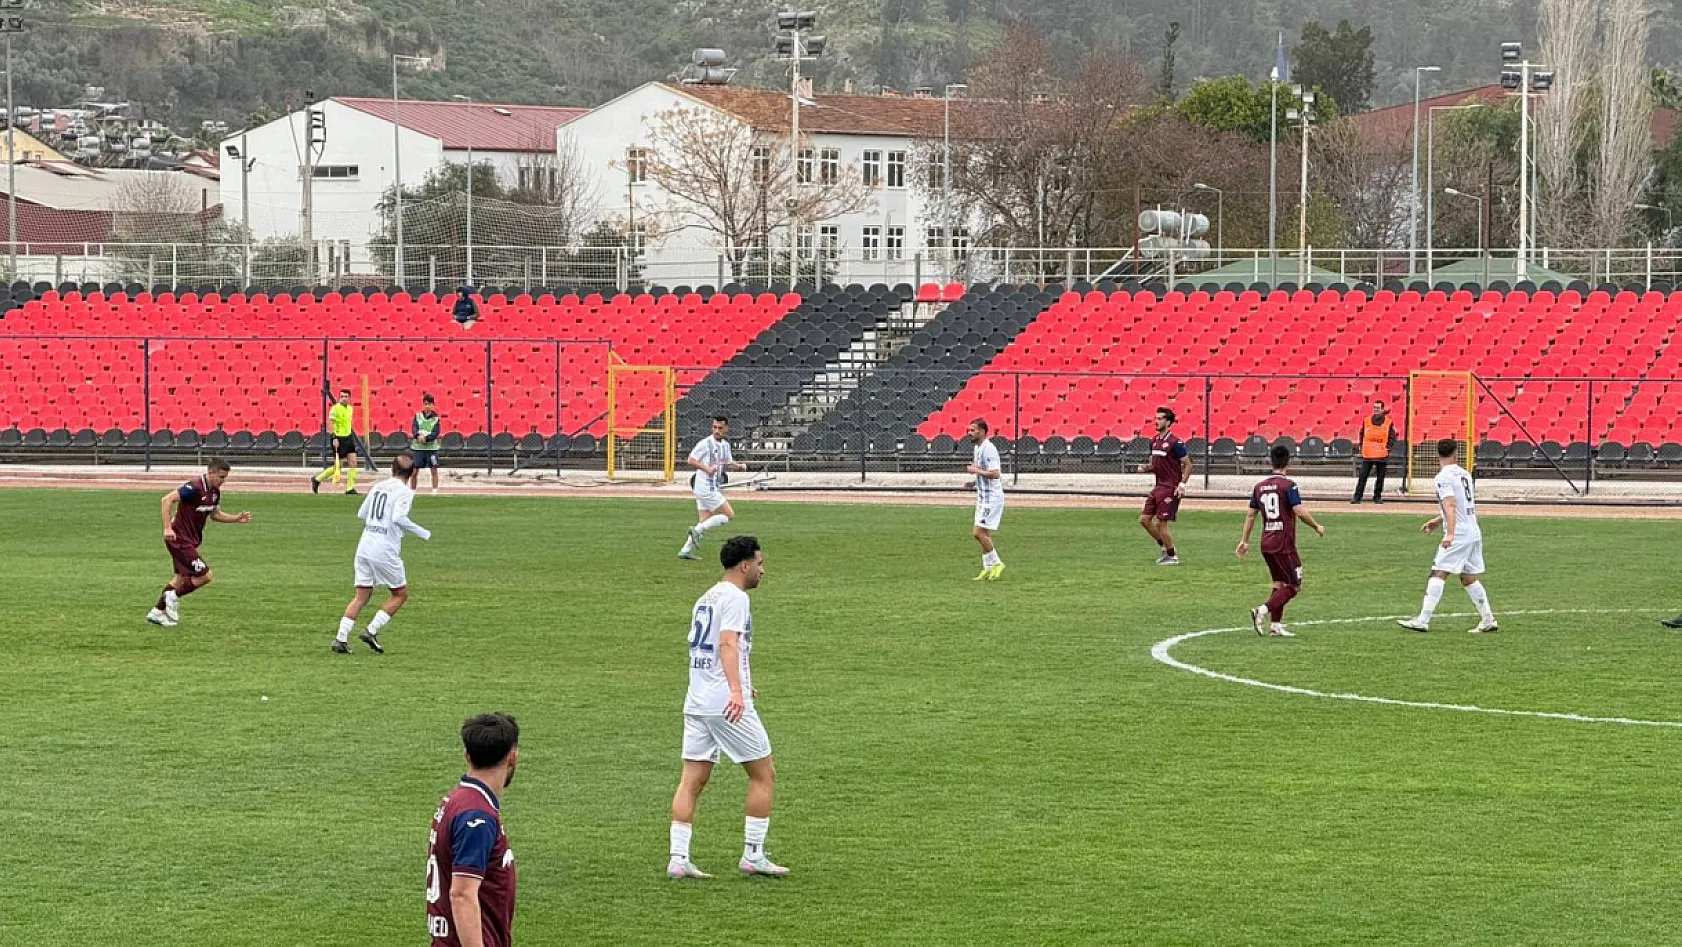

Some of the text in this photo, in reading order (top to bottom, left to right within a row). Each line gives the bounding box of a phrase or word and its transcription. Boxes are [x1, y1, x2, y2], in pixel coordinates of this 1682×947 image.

[1460, 476, 1472, 502] 8
[371, 491, 388, 520] 10
[1260, 492, 1280, 519] 19
